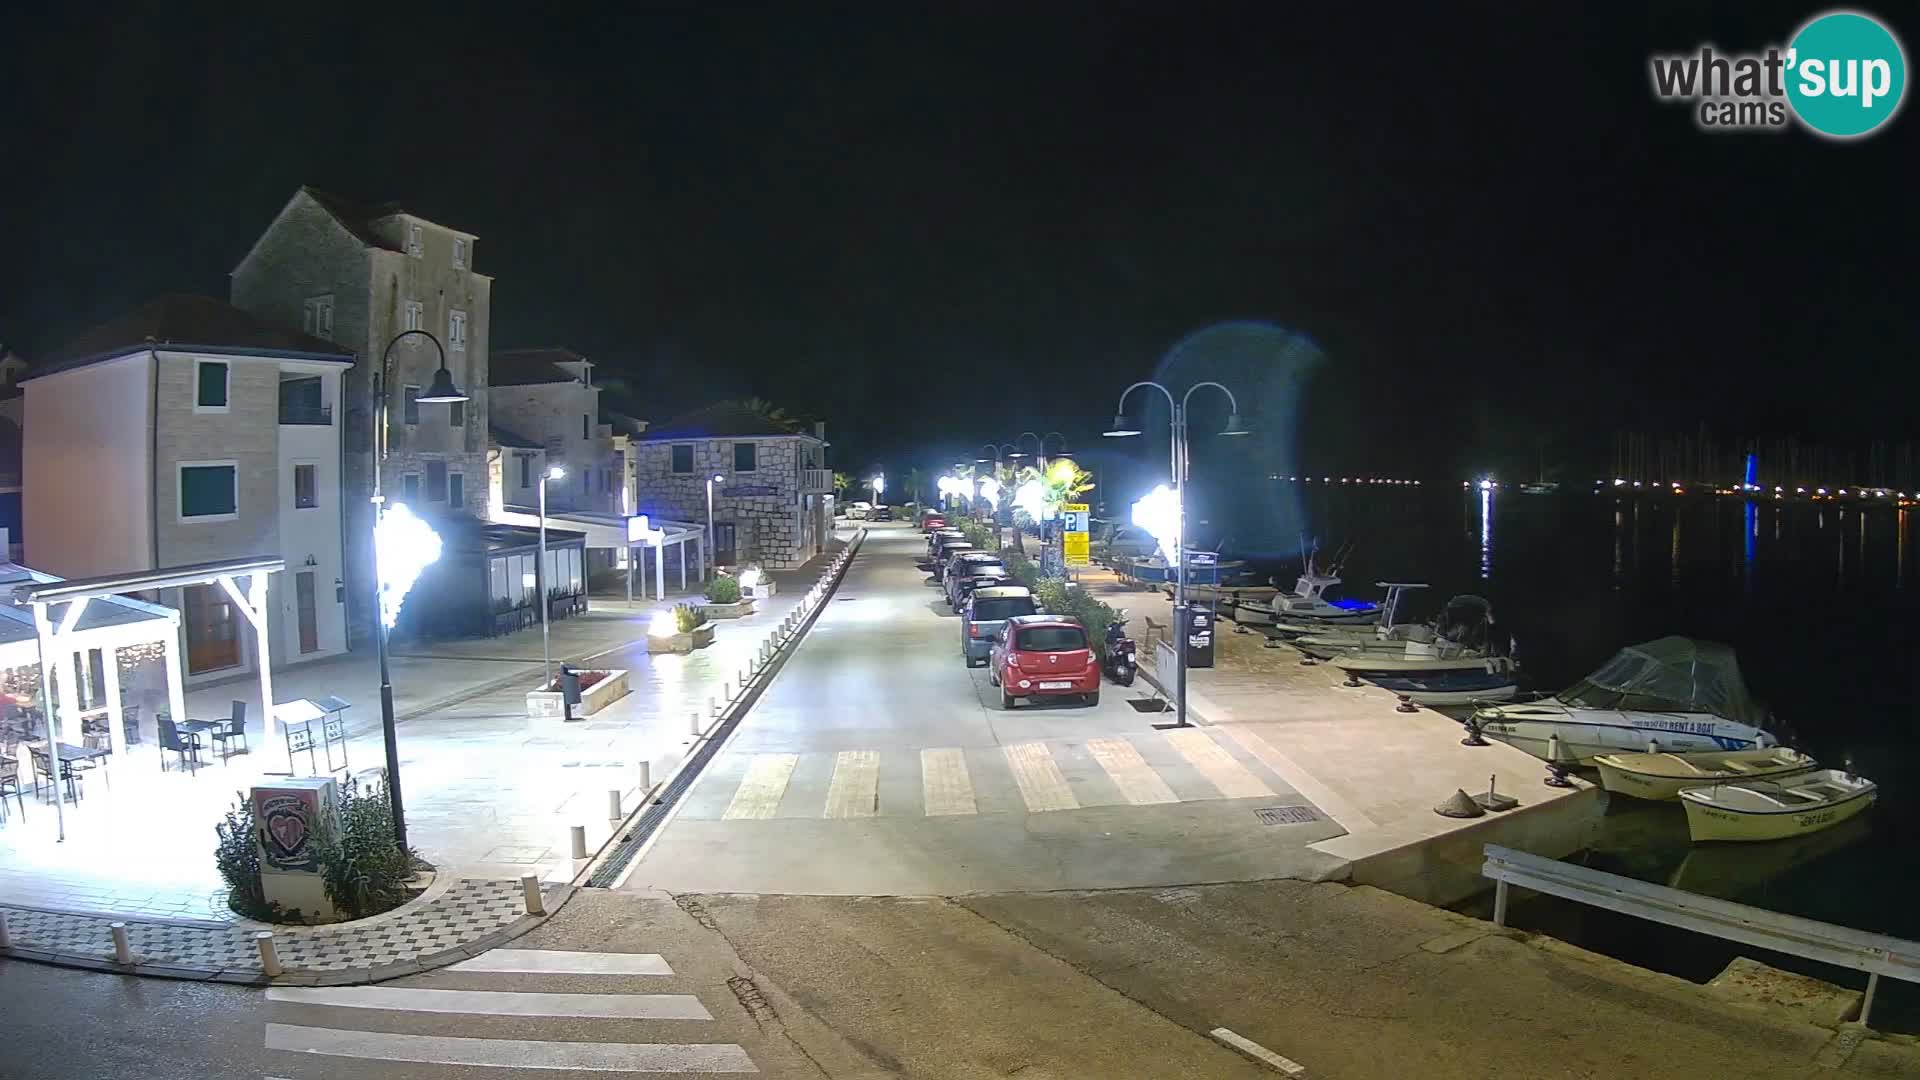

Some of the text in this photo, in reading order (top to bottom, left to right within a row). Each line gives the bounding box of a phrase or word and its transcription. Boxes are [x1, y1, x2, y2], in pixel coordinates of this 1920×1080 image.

[1065, 513, 1076, 530] P
[1669, 721, 1689, 733] RENT
[1696, 722, 1716, 735] BOAT
